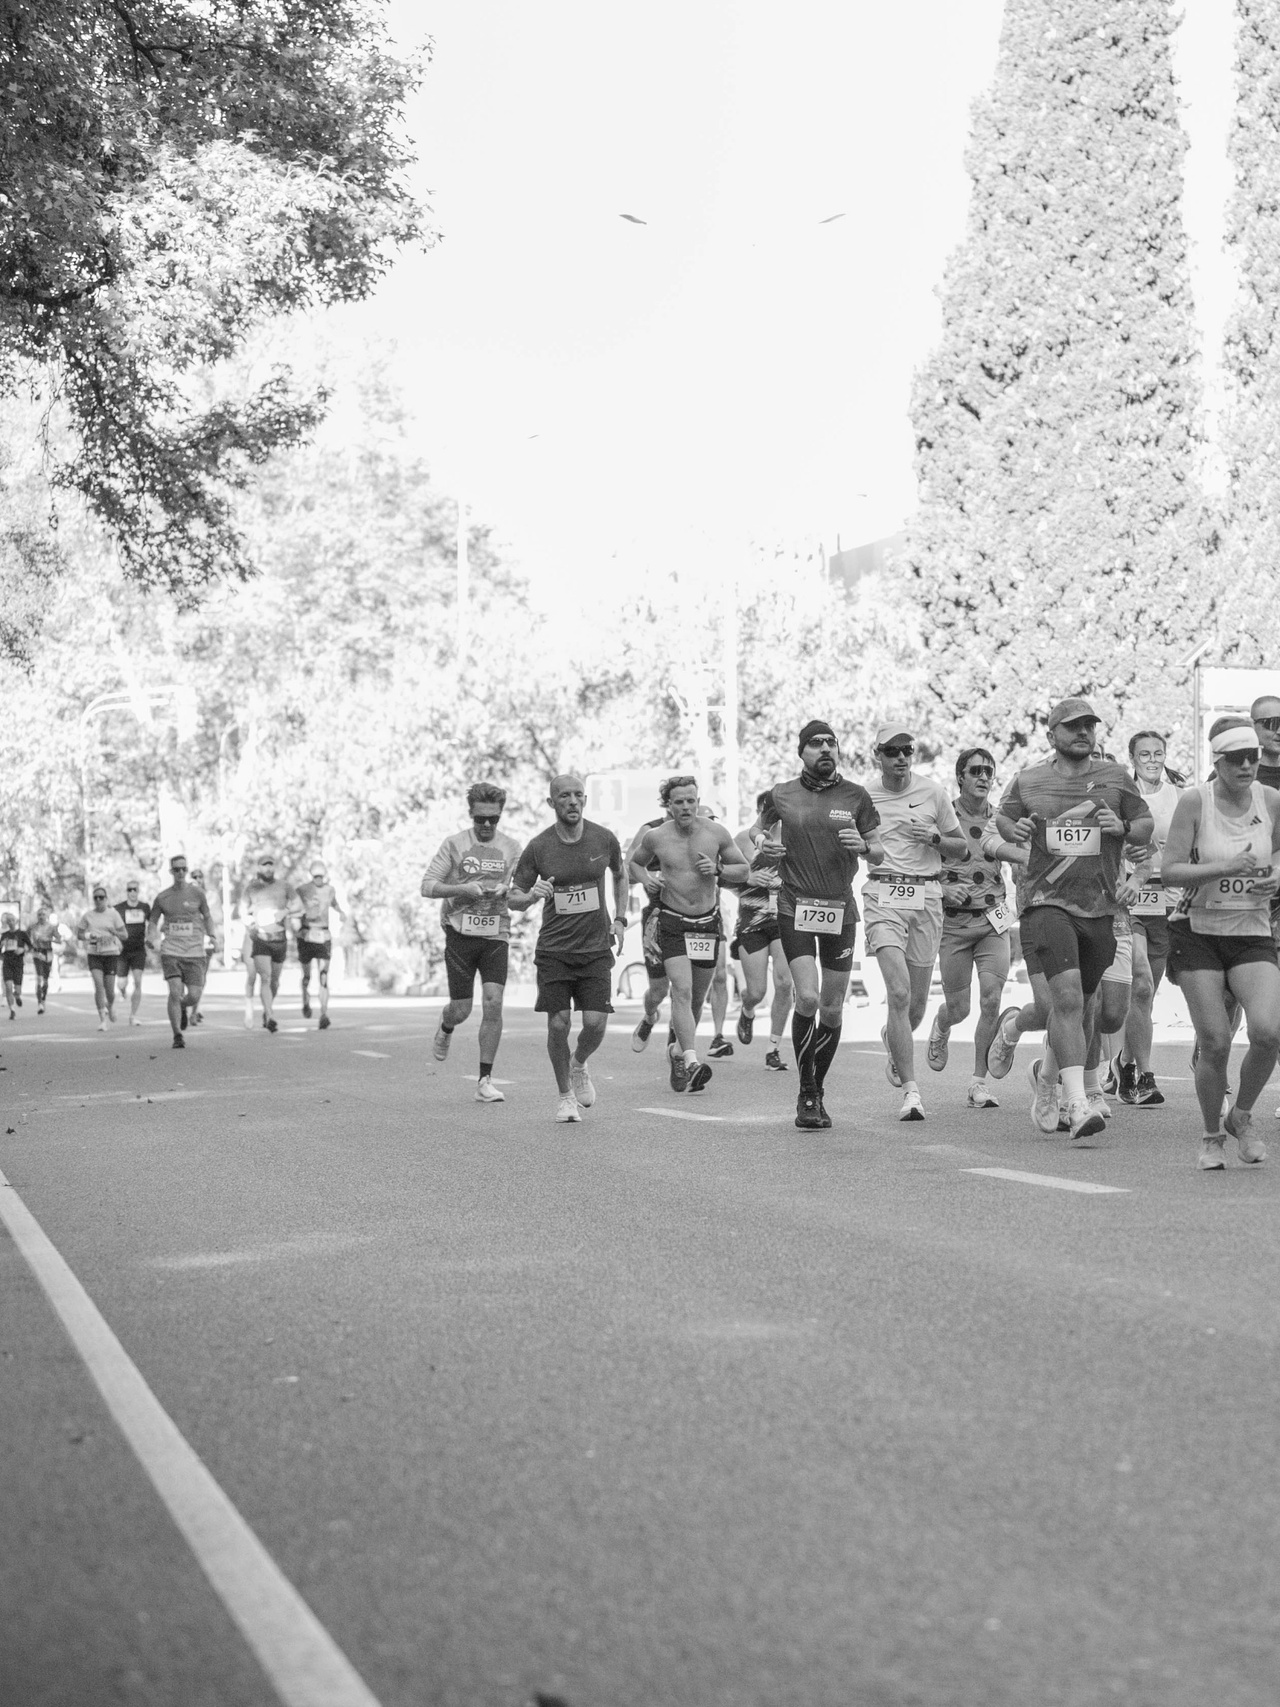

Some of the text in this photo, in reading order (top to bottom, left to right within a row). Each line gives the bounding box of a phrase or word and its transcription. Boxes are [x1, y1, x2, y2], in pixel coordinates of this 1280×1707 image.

[1056, 829, 1091, 841] 1617
[889, 885, 915, 897] 799
[1220, 879, 1255, 894] 802
[566, 891, 586, 903] 711
[468, 915, 495, 927] 1065
[803, 909, 836, 923] 1730
[689, 941, 710, 952] 1292
